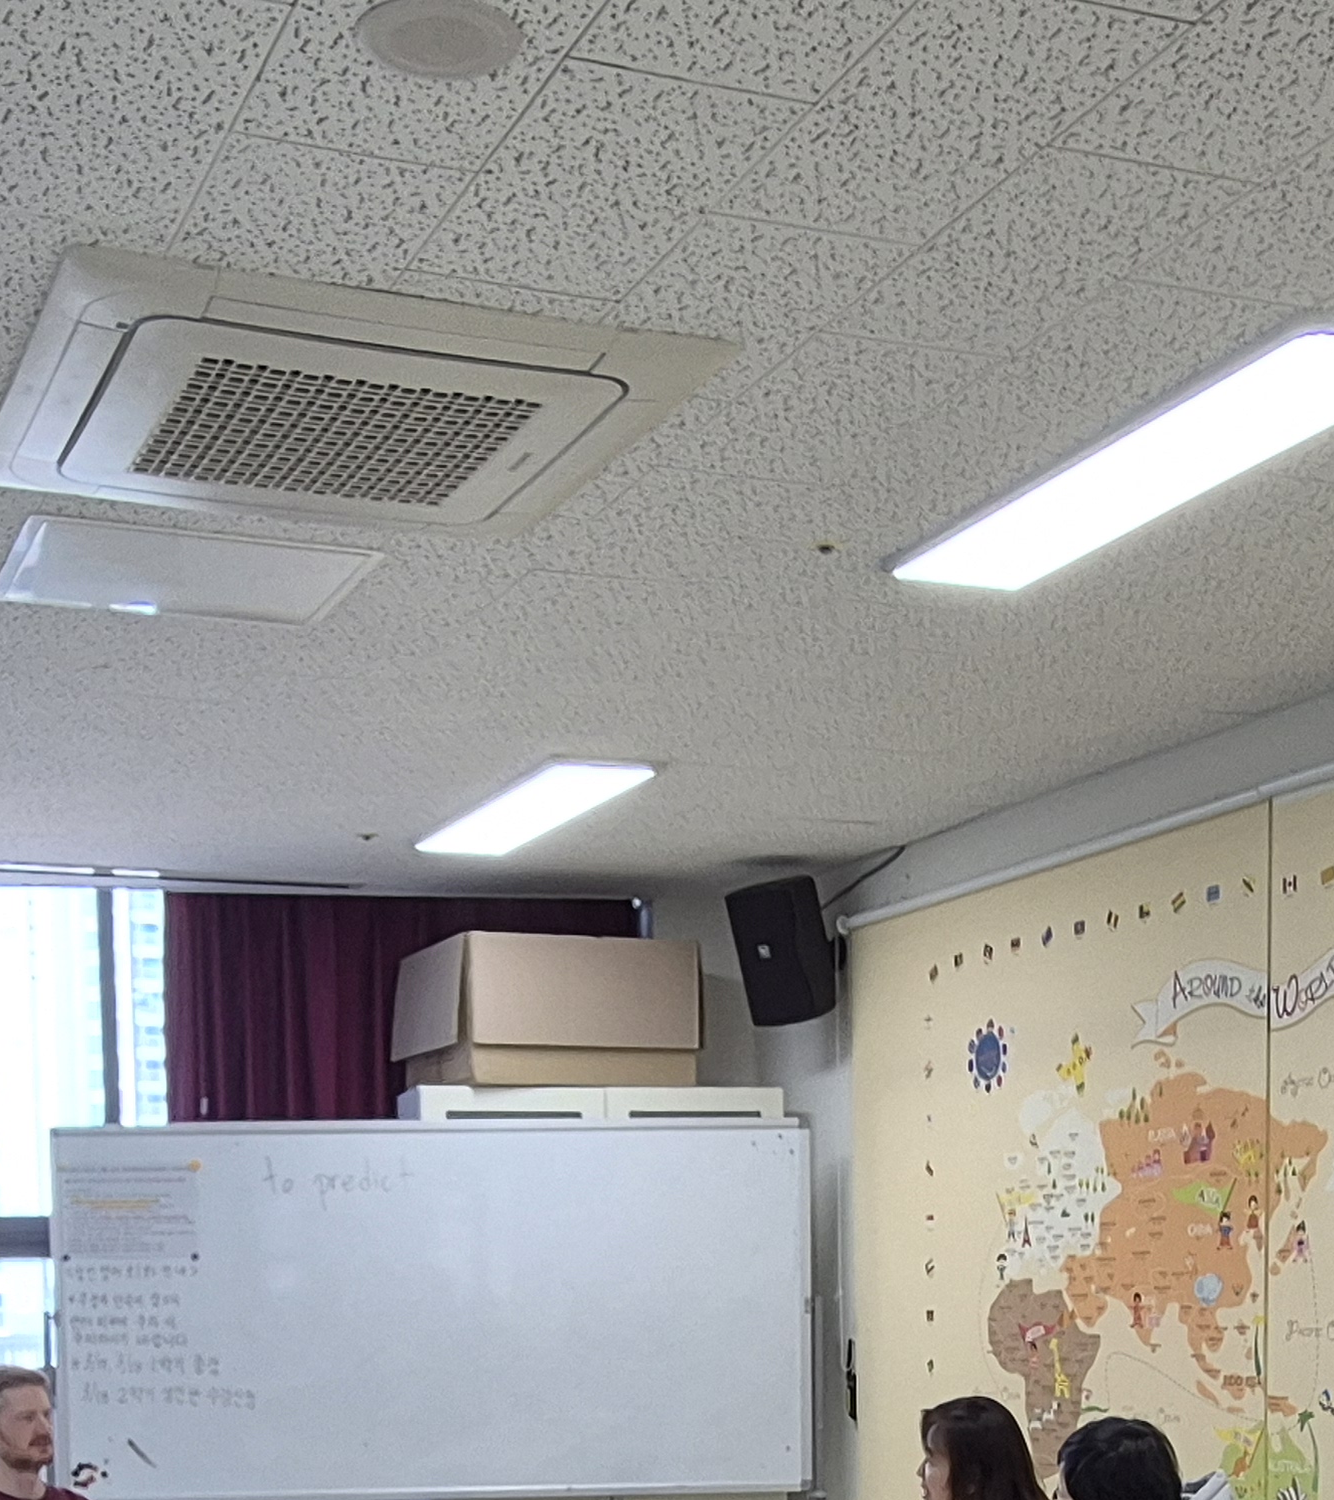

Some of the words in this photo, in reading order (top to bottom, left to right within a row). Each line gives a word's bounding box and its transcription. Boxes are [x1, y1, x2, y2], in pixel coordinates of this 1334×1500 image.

[1171, 970, 1242, 1009] AROUND
[262, 1155, 294, 1195] to
[312, 1156, 414, 1212] predict
